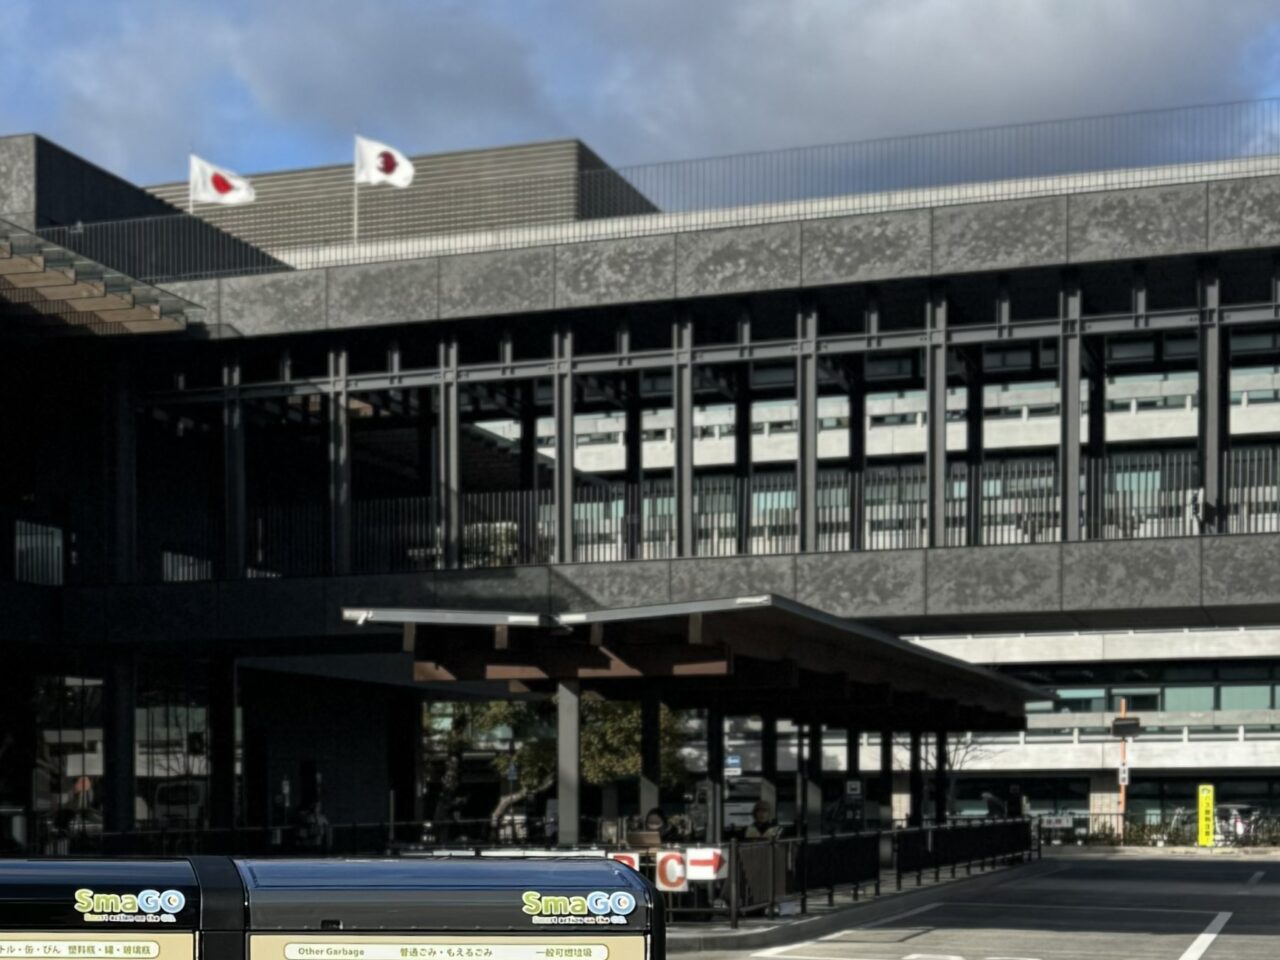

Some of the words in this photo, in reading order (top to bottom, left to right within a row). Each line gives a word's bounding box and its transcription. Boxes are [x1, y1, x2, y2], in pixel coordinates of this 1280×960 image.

[659, 854, 685, 888] C
[74, 888, 185, 913] SmaGO
[522, 891, 636, 915] SmaGO
[298, 947, 324, 956] Other
[326, 947, 365, 957] Garbage
